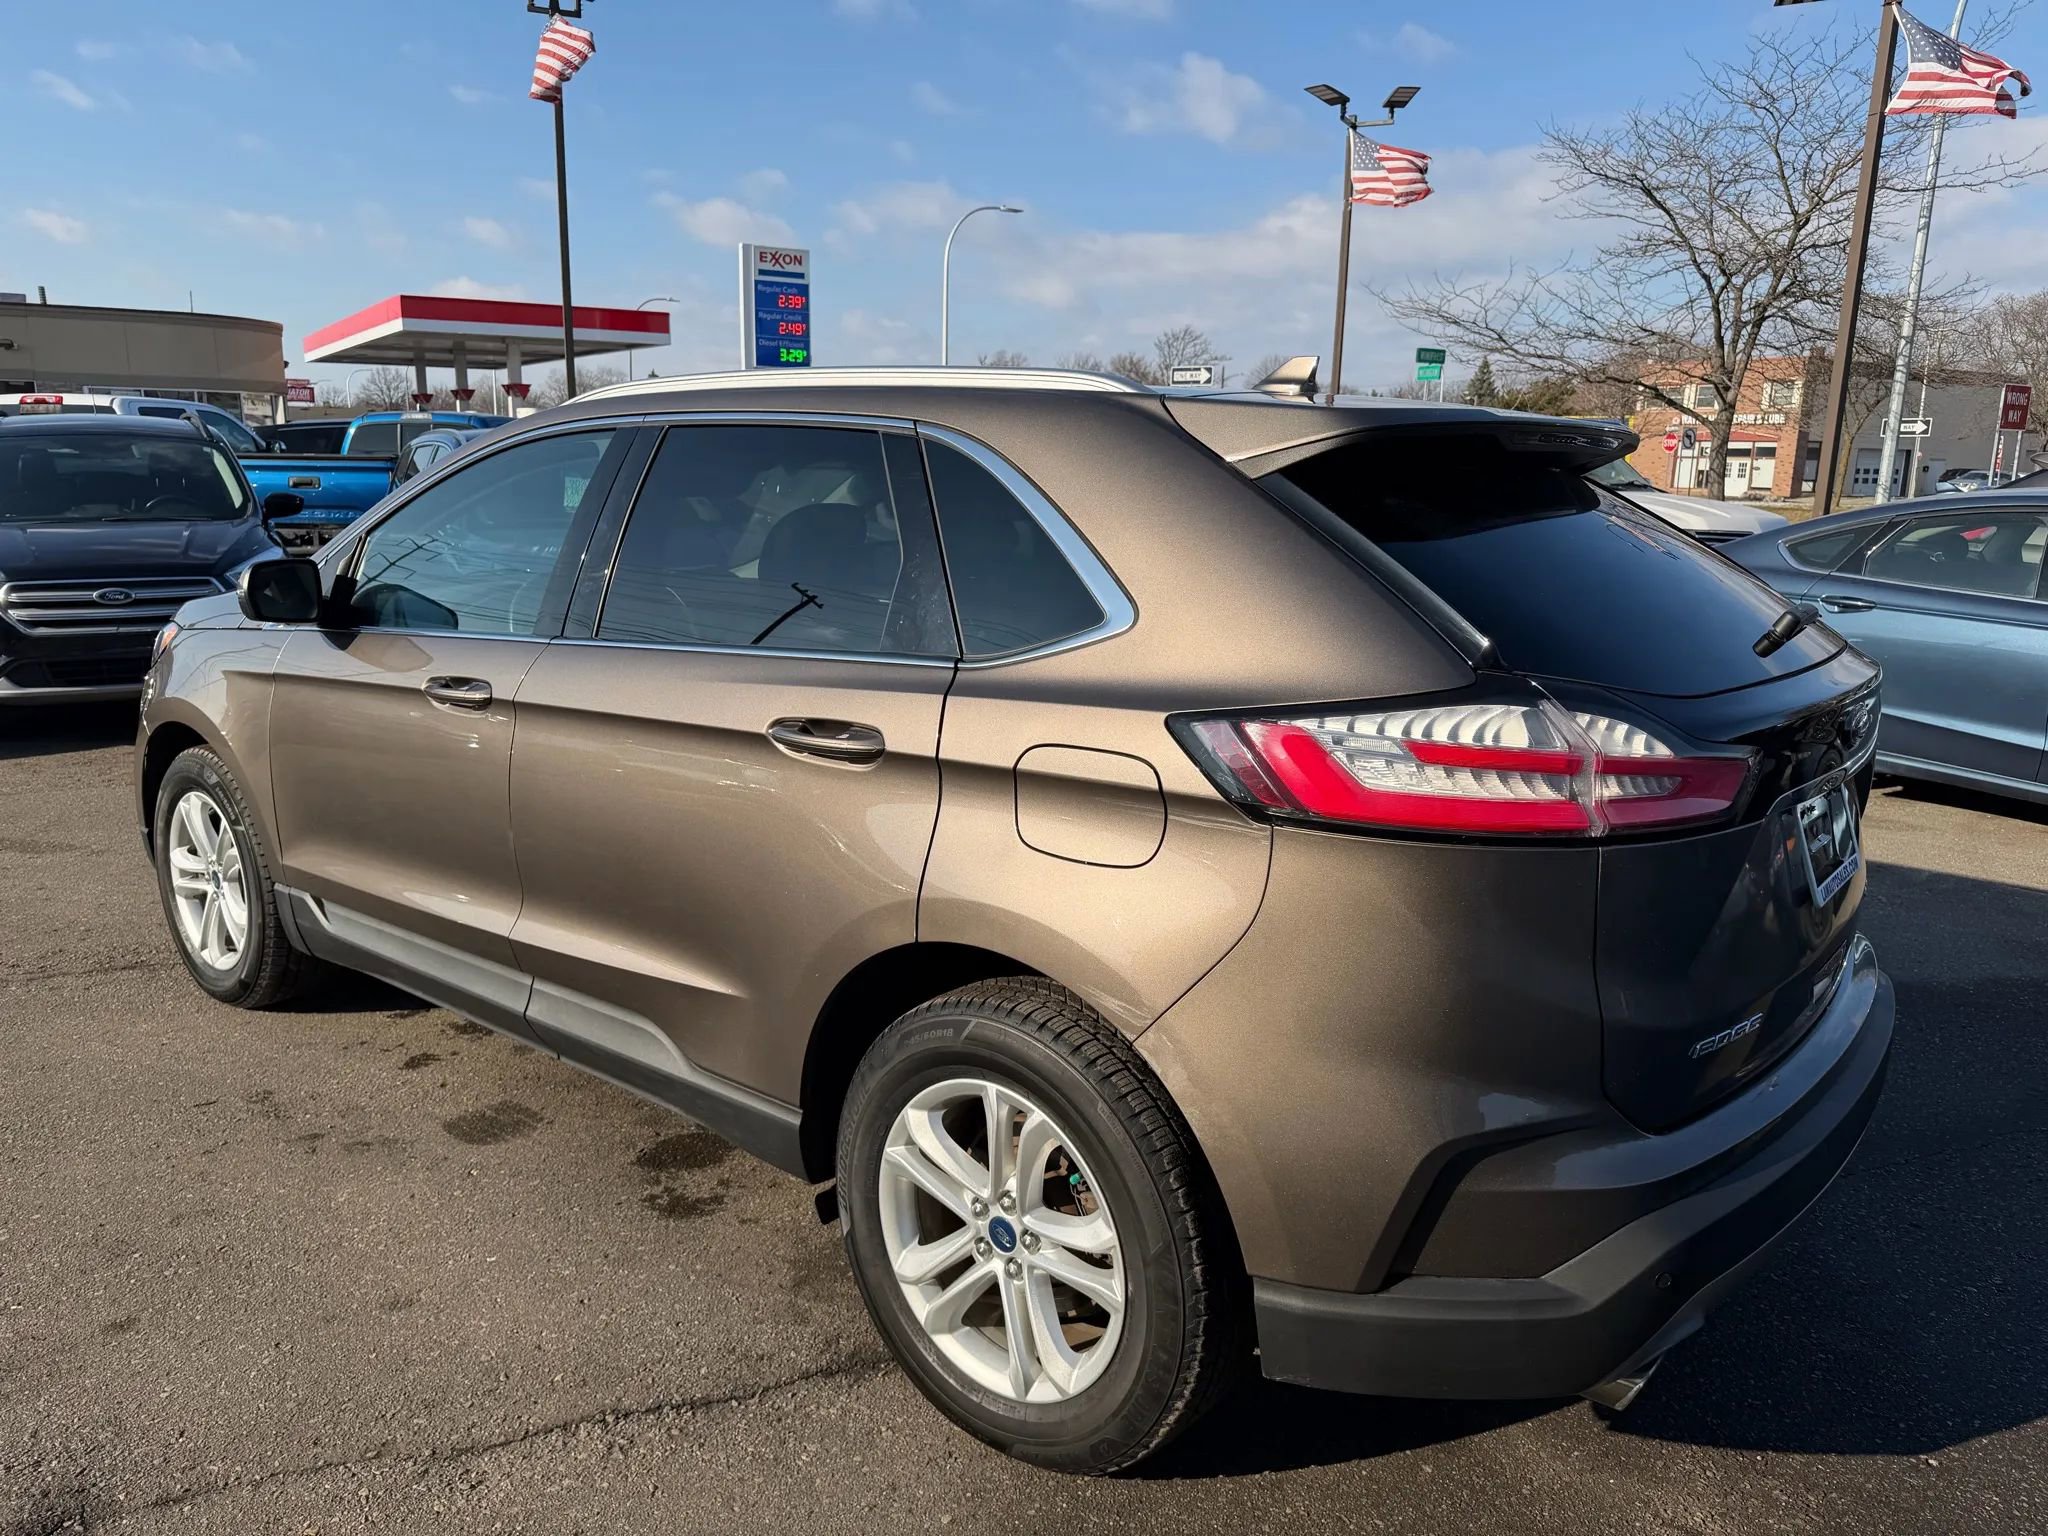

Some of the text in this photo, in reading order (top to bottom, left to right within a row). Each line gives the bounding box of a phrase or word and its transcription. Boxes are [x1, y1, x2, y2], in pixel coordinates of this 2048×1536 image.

[759, 251, 803, 269] EXXON
[757, 284, 781, 294] Regular
[758, 311, 782, 321] Regular
[758, 339, 778, 347] Diesel
[2006, 392, 2028, 405] WRONG
[1732, 413, 1755, 425] EPAIR
[2008, 410, 2022, 422] WAY
[1664, 439, 1678, 447] STOP
[103, 592, 126, 601] Ford
[1688, 1012, 1764, 1059] EDGE
